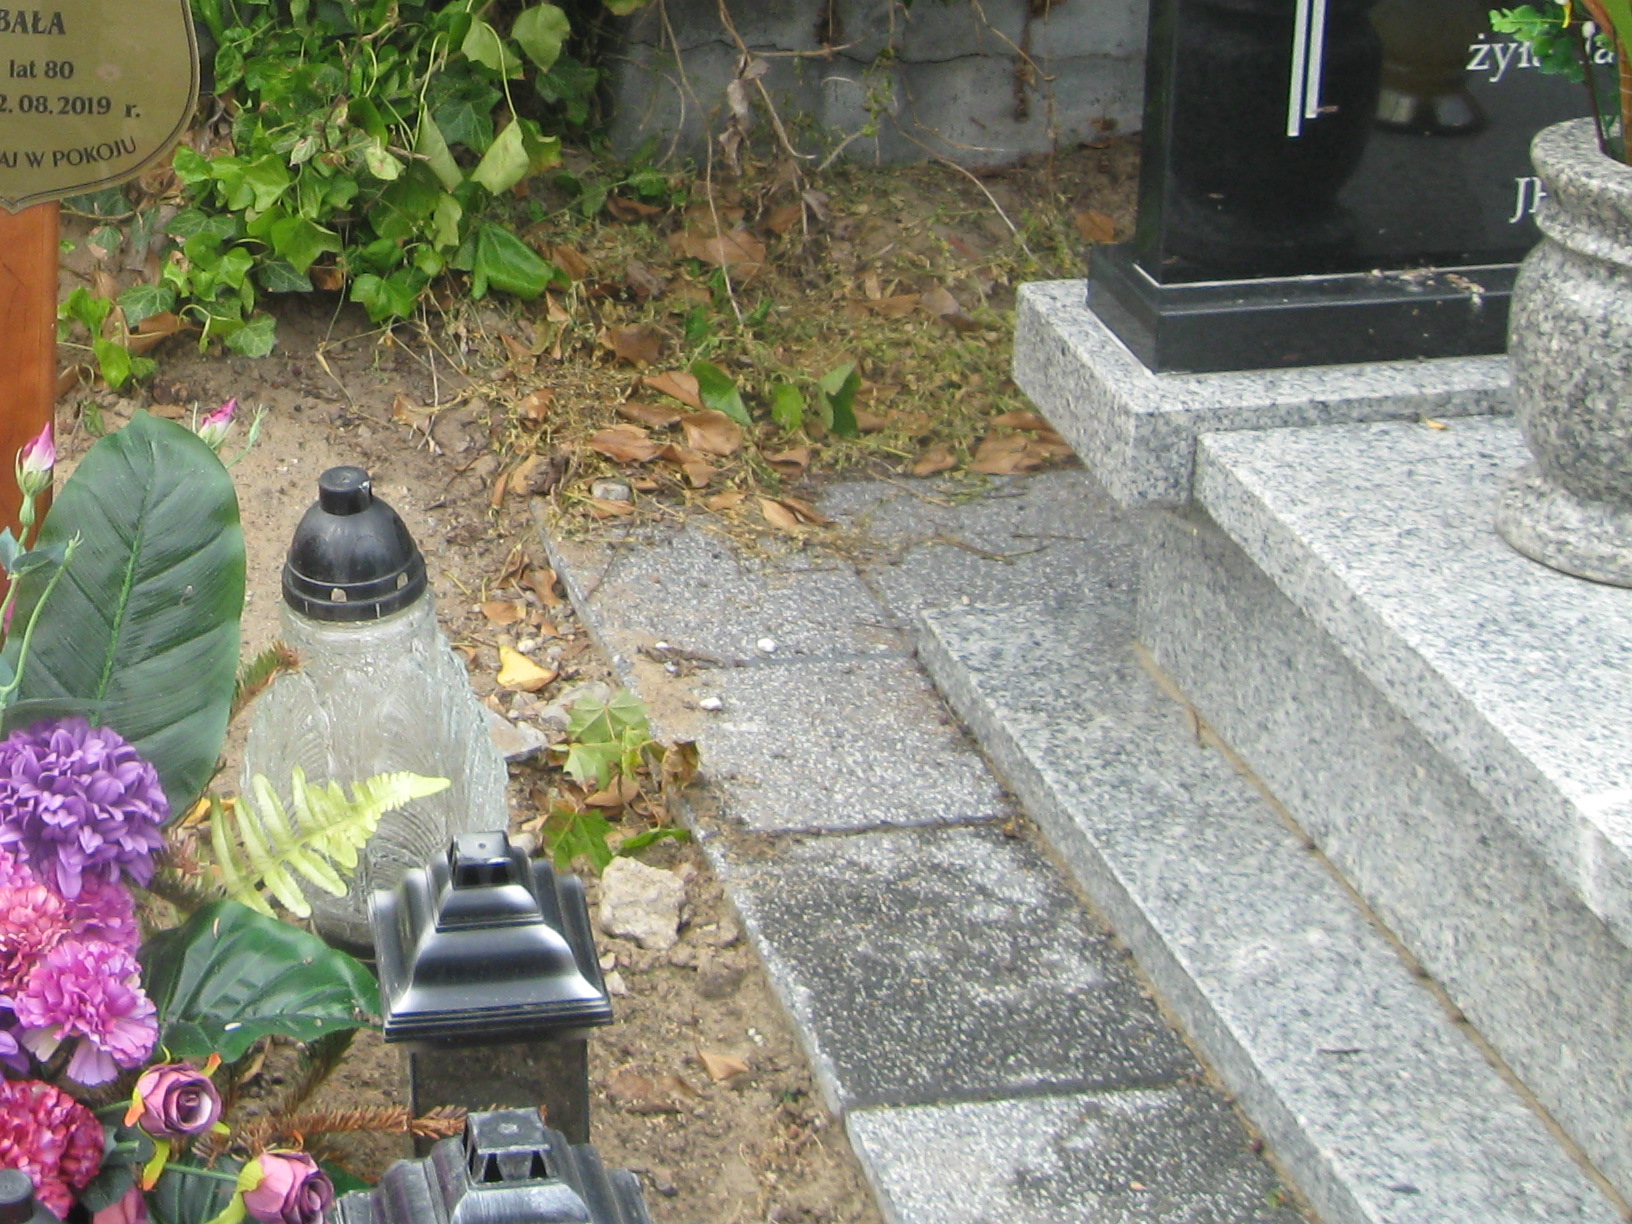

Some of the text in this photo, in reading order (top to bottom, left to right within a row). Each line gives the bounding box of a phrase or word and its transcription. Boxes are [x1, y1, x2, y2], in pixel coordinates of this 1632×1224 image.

[9, 58, 38, 79] lat
[44, 60, 75, 80] 80
[124, 102, 142, 119] r.
[25, 151, 46, 168] W
[53, 136, 137, 168] POKOJU
